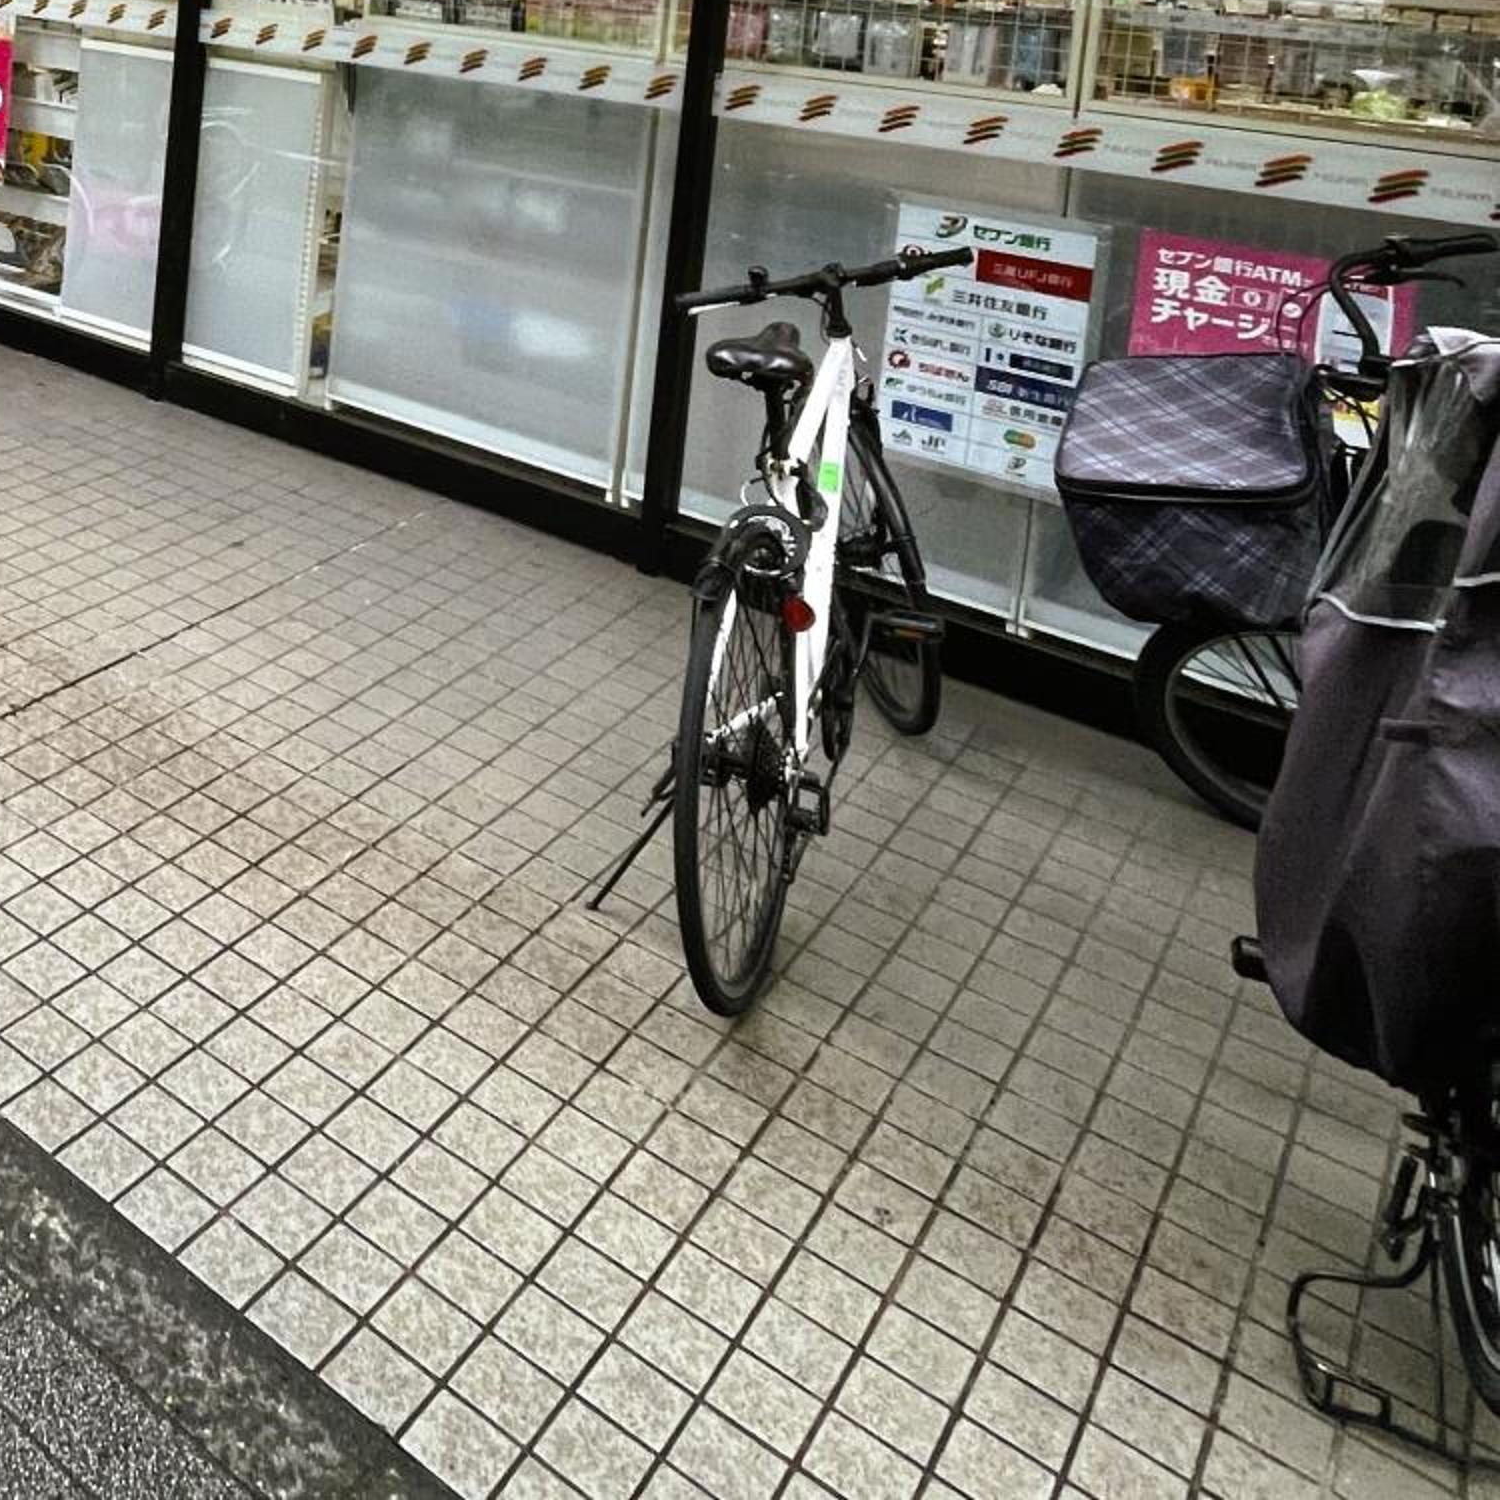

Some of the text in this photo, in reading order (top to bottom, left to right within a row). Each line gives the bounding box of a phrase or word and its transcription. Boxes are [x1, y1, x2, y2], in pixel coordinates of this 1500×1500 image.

[973, 224, 1053, 252] セブン銀行
[1153, 267, 1232, 307] 現金
[952, 289, 1049, 321] 三井住友銀行
[1150, 297, 1272, 341] チャージ
[1009, 327, 1078, 355] りそな銀行
